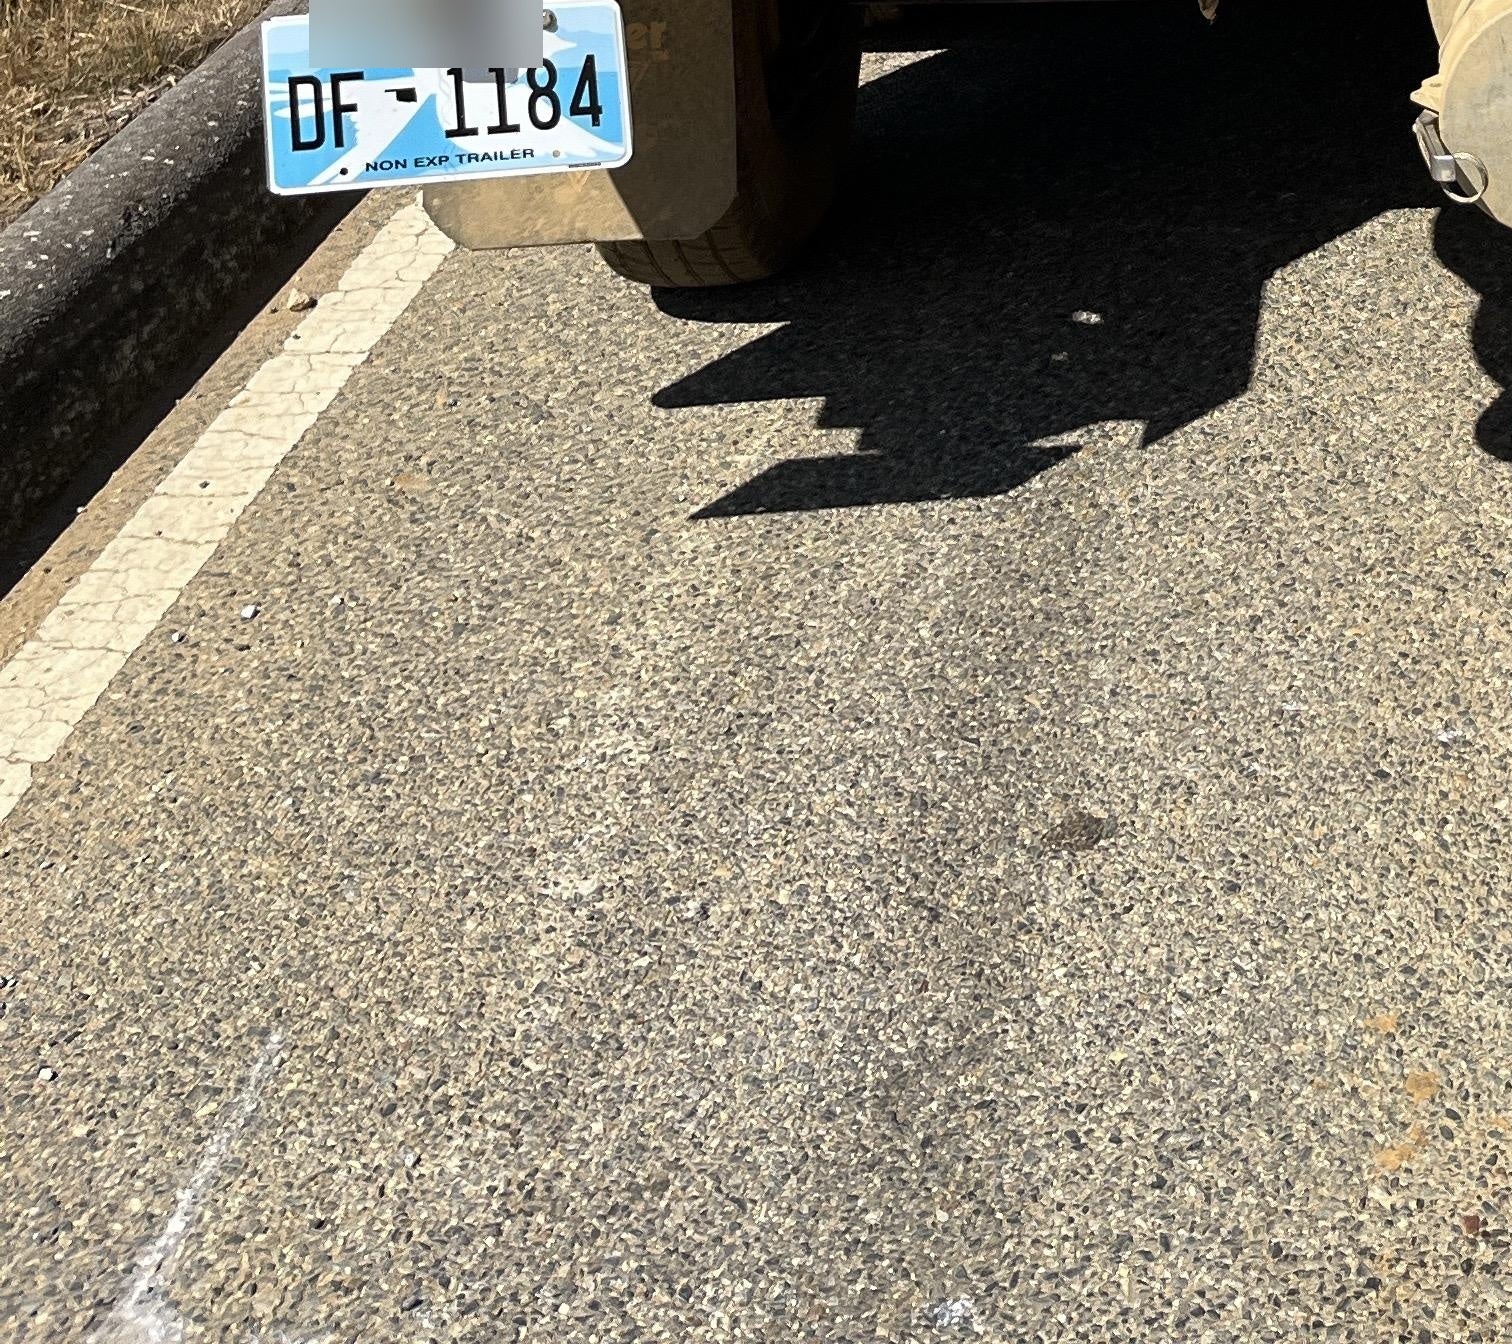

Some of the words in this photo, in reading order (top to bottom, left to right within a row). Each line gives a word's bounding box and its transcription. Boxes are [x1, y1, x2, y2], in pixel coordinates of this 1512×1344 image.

[365, 158, 407, 172] NON
[414, 155, 450, 168] EXP
[455, 148, 535, 164] TRAILER
